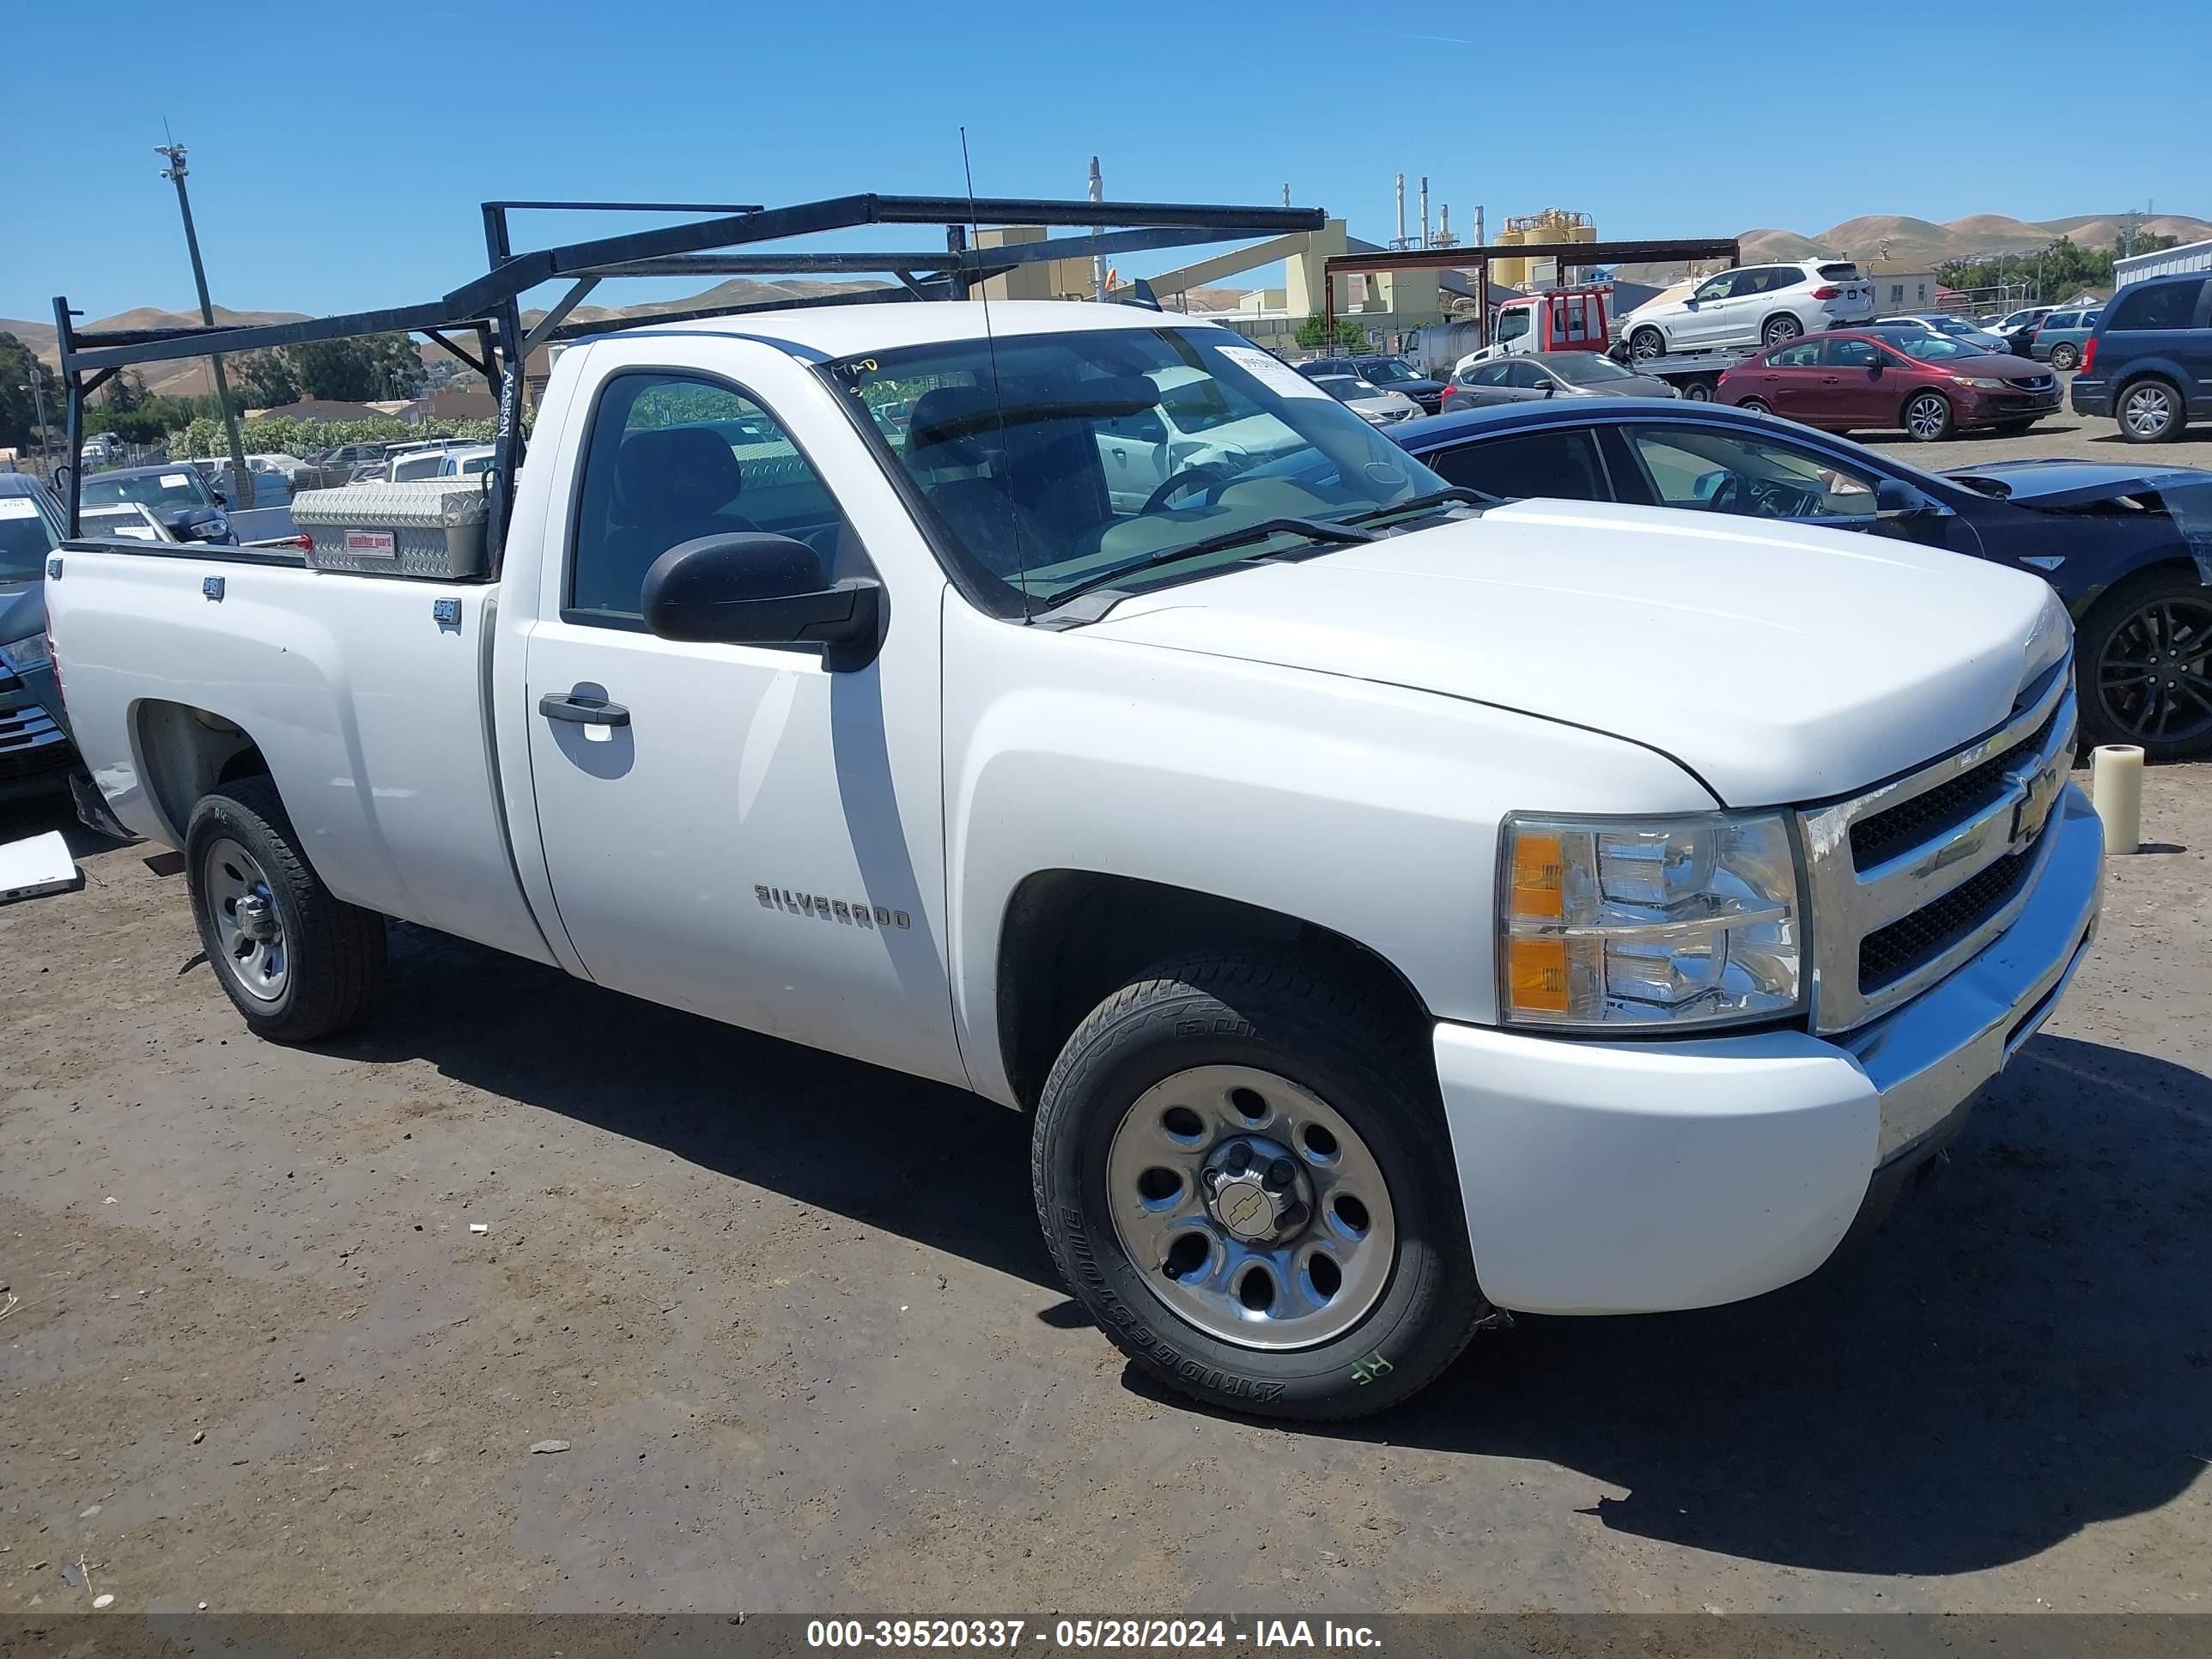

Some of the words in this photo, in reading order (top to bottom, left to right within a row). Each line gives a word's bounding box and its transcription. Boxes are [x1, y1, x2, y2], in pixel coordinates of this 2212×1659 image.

[496, 369, 514, 439] ALASKAN
[349, 535, 374, 545] weather
[374, 536, 392, 548] guard
[754, 884, 910, 931] SILVERADO
[1061, 1205, 1289, 1404] BRIDGESTONE
[1350, 1348, 1395, 1387] RF
